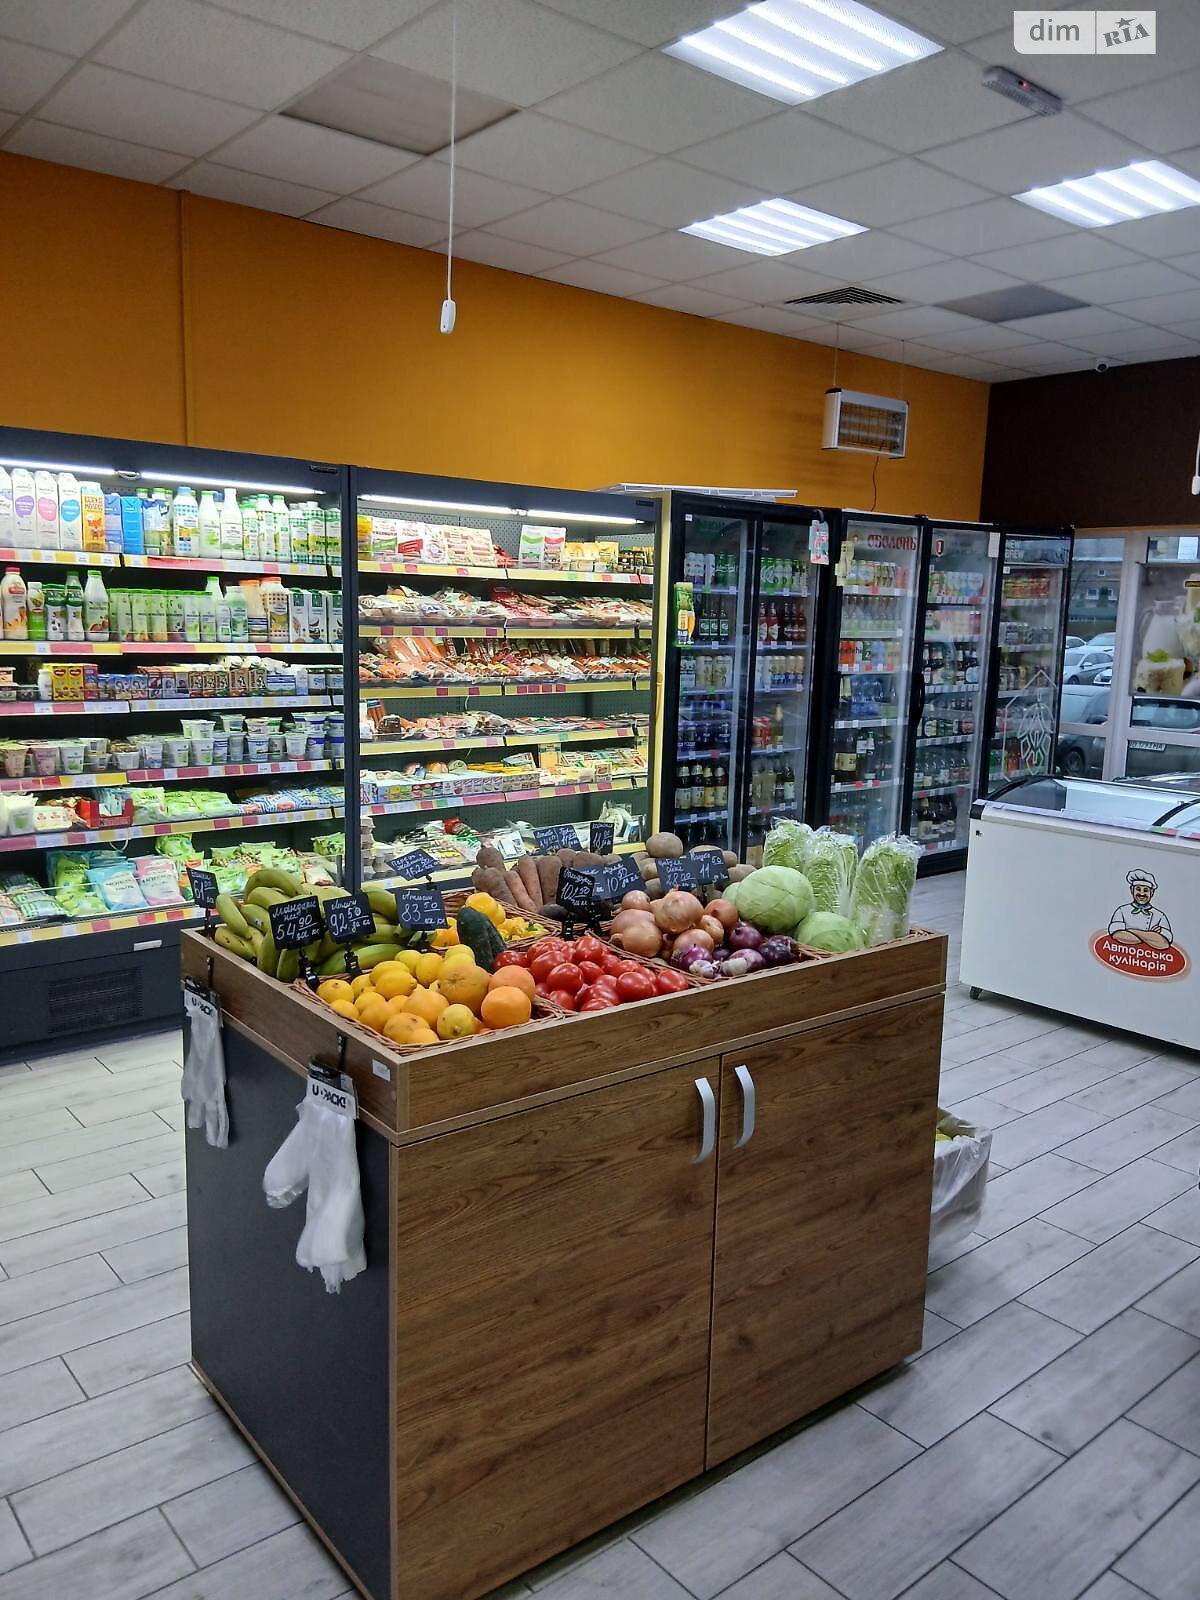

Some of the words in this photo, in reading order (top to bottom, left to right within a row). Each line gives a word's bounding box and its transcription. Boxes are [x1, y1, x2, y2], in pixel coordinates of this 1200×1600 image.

[867, 534, 917, 551] ОБОЛОНЬ
[402, 903, 421, 922] 83
[276, 922, 296, 940] 54
[298, 914, 312, 928] 90
[330, 912, 348, 936] 92
[1103, 940, 1174, 962] Авторська
[1109, 954, 1167, 972] кулінарія
